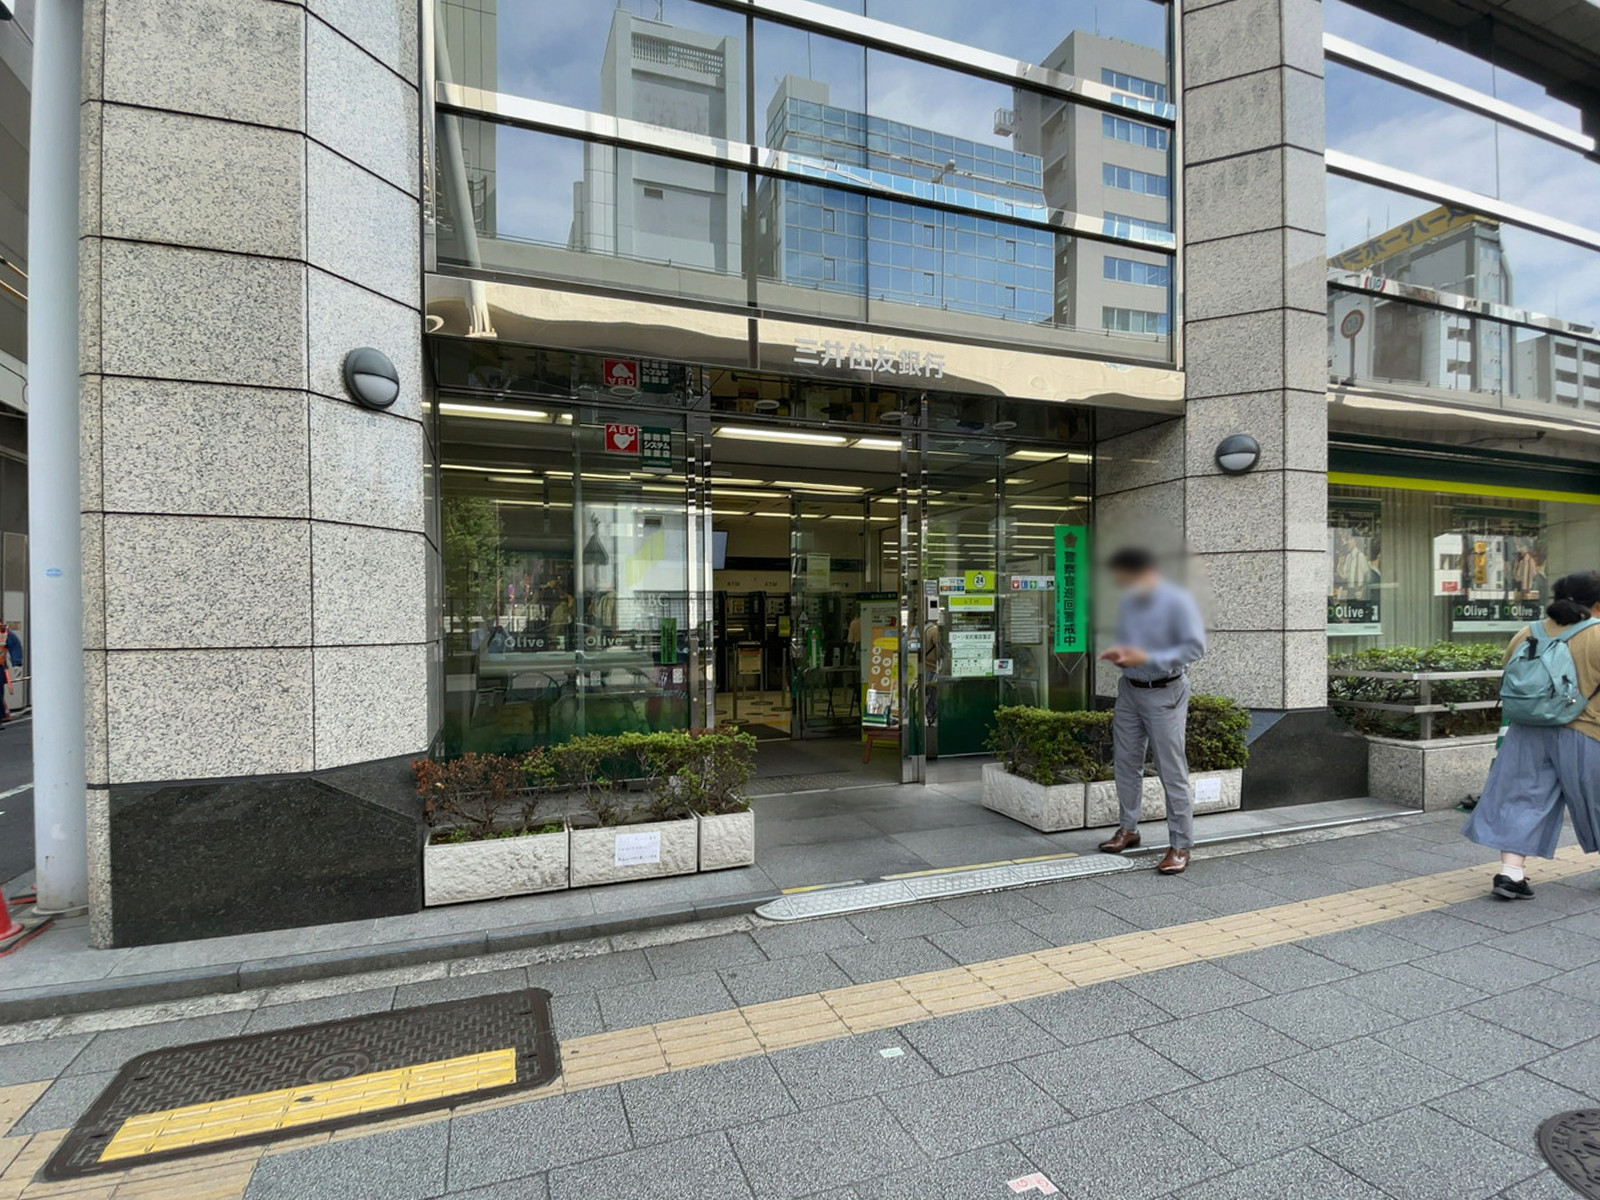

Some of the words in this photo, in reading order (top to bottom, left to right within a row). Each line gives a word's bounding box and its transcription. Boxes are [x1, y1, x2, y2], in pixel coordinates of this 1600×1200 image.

[794, 338, 945, 379] 三井住友銀行
[608, 425, 636, 434] AED
[975, 576, 984, 584] 24
[1335, 605, 1364, 618] Olive
[1463, 604, 1488, 616] Olive
[1511, 605, 1533, 617] Olive
[504, 635, 545, 648] Olive
[585, 634, 623, 647] Olive
